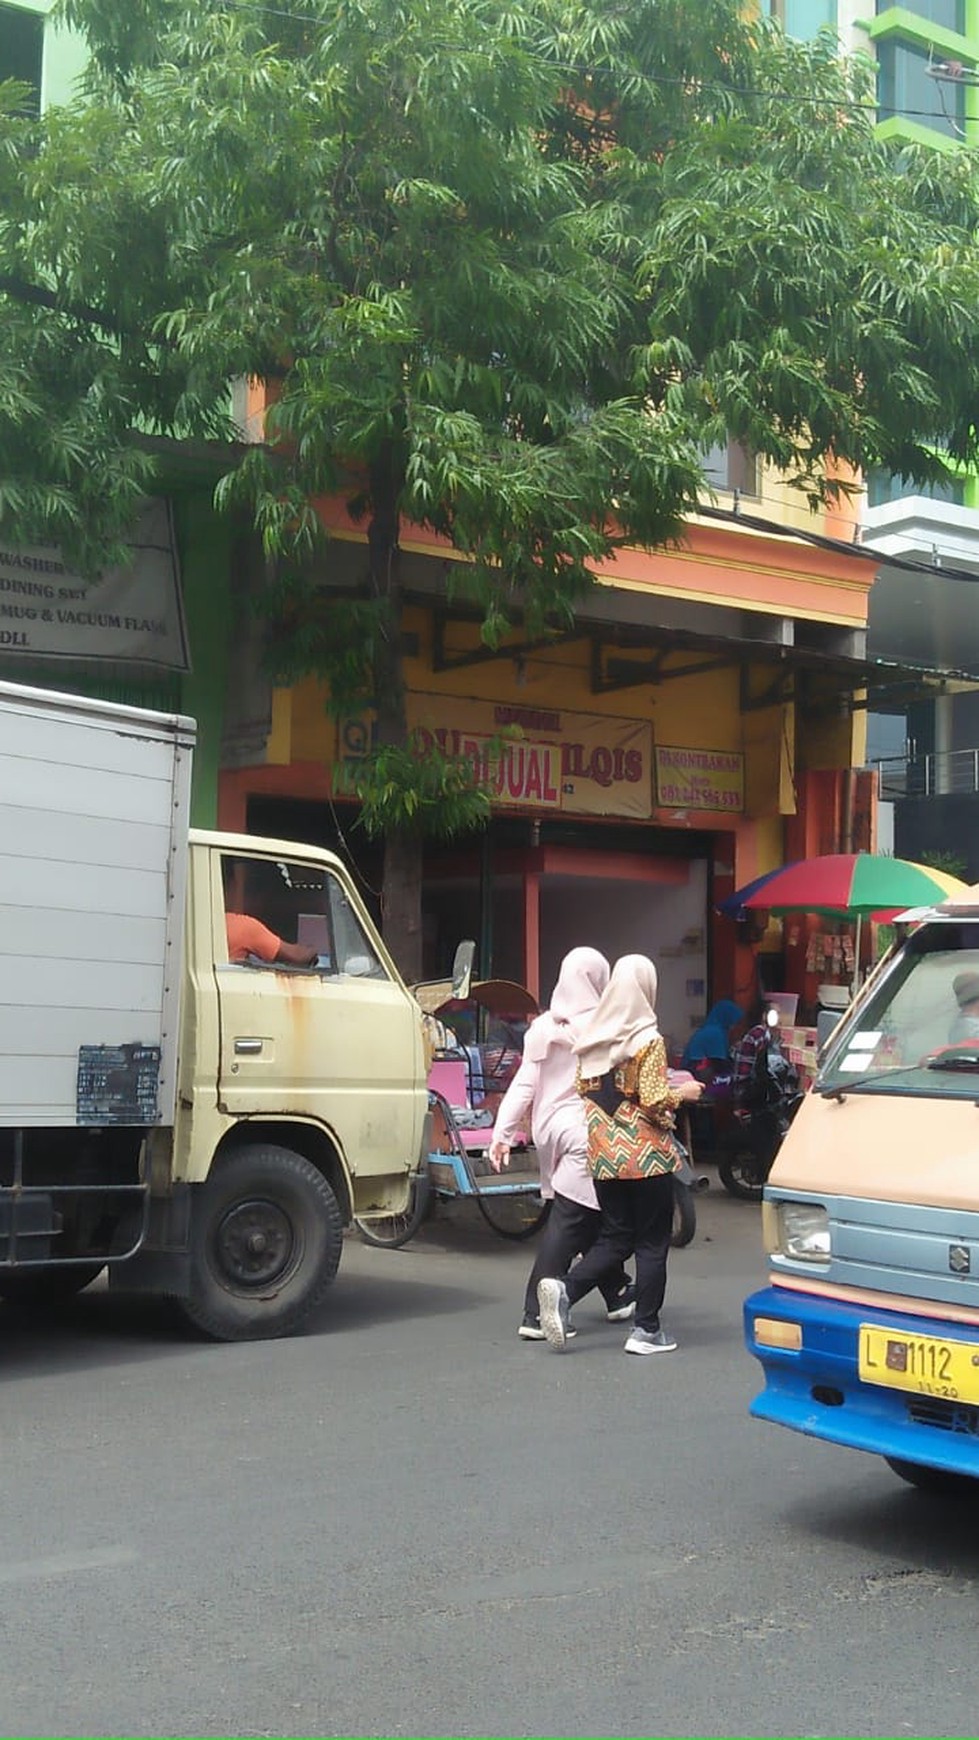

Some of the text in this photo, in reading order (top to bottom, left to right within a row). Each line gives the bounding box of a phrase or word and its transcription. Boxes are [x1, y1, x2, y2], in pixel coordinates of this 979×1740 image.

[0, 578, 87, 600] DINING SET
[0, 604, 38, 621] MUG
[41, 609, 53, 622] &
[57, 609, 121, 629] VACUUM
[0, 630, 30, 646] DLL
[866, 1334, 953, 1381] L 1112
[918, 1381, 958, 1399] 11-20
